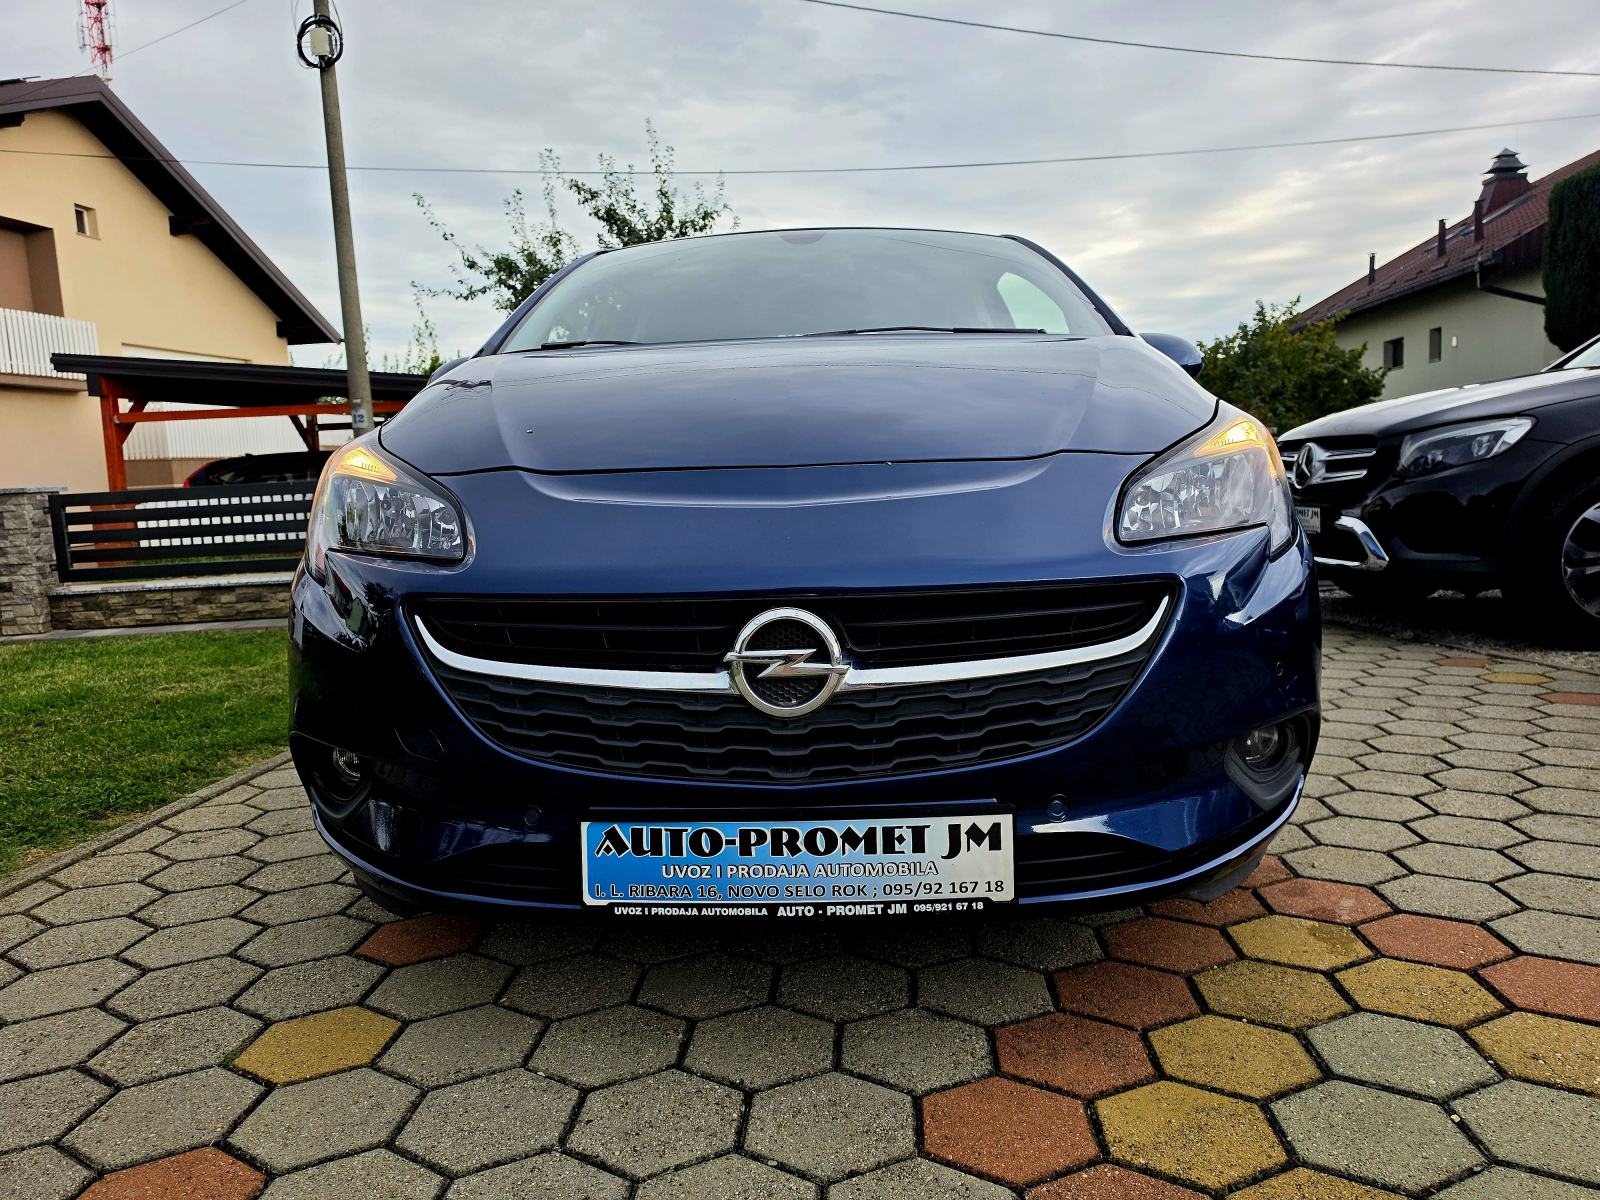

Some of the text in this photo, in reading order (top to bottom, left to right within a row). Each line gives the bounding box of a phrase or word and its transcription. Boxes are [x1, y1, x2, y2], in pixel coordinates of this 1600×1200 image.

[353, 414, 365, 424] 12
[594, 822, 1002, 860] AUTO-PROMET JM
[662, 860, 939, 879] UVOZ I PRODAJA AUTOMOBILA
[595, 884, 606, 898] I.
[610, 885, 624, 898] L.
[629, 885, 693, 898] RIBARA
[697, 885, 722, 900] 16,
[728, 885, 780, 898] NOVO
[784, 884, 826, 898] SELO
[831, 884, 868, 897] ROK
[882, 881, 943, 898] 095/92
[948, 881, 979, 895] 167
[984, 880, 1005, 893] 18
[614, 906, 642, 916] UVOZ
[651, 907, 699, 917] PRODAJA
[701, 907, 769, 917] AUTOMOBILA
[777, 905, 815, 918] AUTO
[826, 904, 885, 917] PROMET
[887, 903, 908, 916] JM
[913, 902, 953, 913] 095/921
[955, 903, 969, 911] 67
[971, 901, 984, 911] 18
